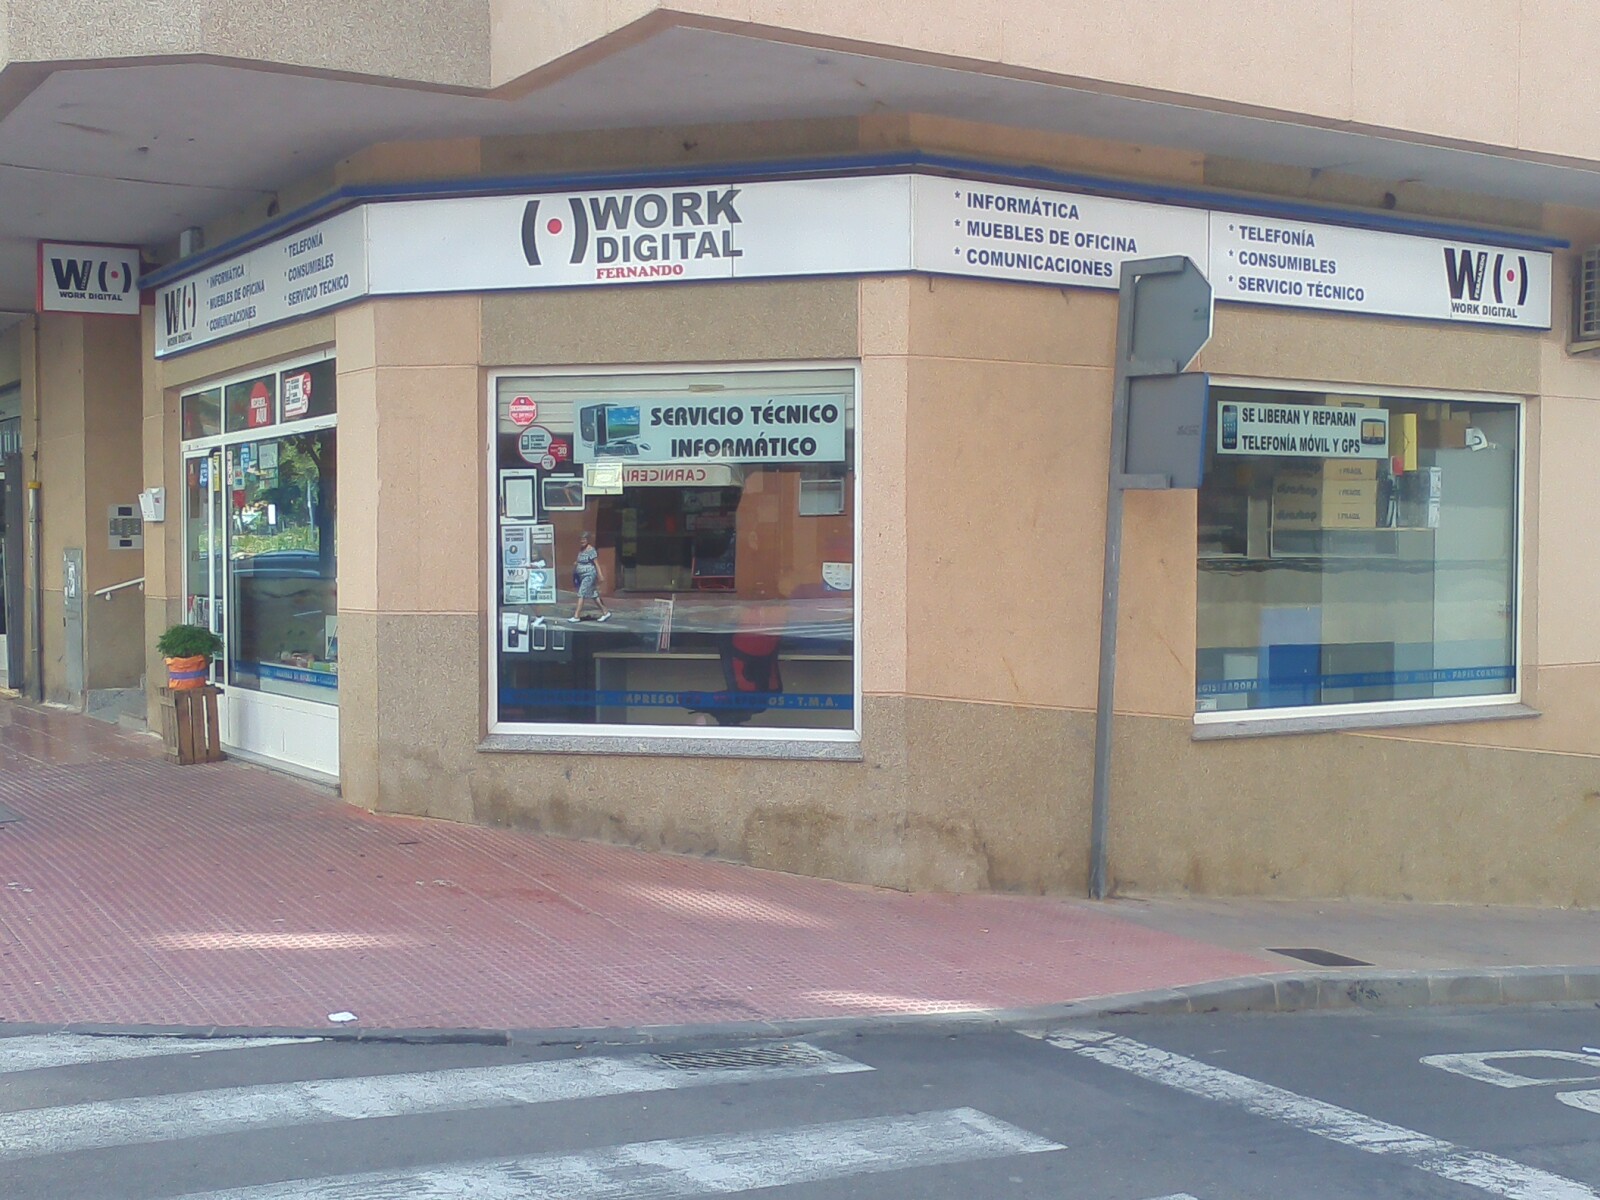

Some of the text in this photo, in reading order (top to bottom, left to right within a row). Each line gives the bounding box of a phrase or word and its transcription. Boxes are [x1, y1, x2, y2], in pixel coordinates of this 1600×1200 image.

[589, 189, 742, 231] WORK
[967, 192, 1079, 220] INFORMÁTICA
[597, 230, 743, 264] DIGITAL
[967, 220, 1137, 253] MUEBLES DE OFICINA
[1239, 226, 1315, 248] TELEFONÍA
[288, 253, 334, 281] CONSUMIBLES
[596, 264, 683, 279] FERNANDO
[967, 249, 1113, 277] COMUNICACIONES
[1239, 251, 1336, 274] CONSUMIBLES
[89, 293, 122, 301] DIGITAL
[210, 280, 265, 310] MUEBLES DE OFICINA
[288, 285, 317, 306] SERVICIO
[1238, 277, 1364, 302] SERVICIO TÉCNICO
[210, 306, 256, 331] COMUNICACIONES
[1451, 302, 1517, 318] WORK DIGITAL
[650, 400, 838, 427] SERVICIO TÉCNICO
[1242, 407, 1356, 427] SE LIBERAN Y REPARAN
[671, 432, 817, 458] INFORMÁTICO
[1242, 433, 1360, 453] TELEFONÍA MÓVIL Y GPS
